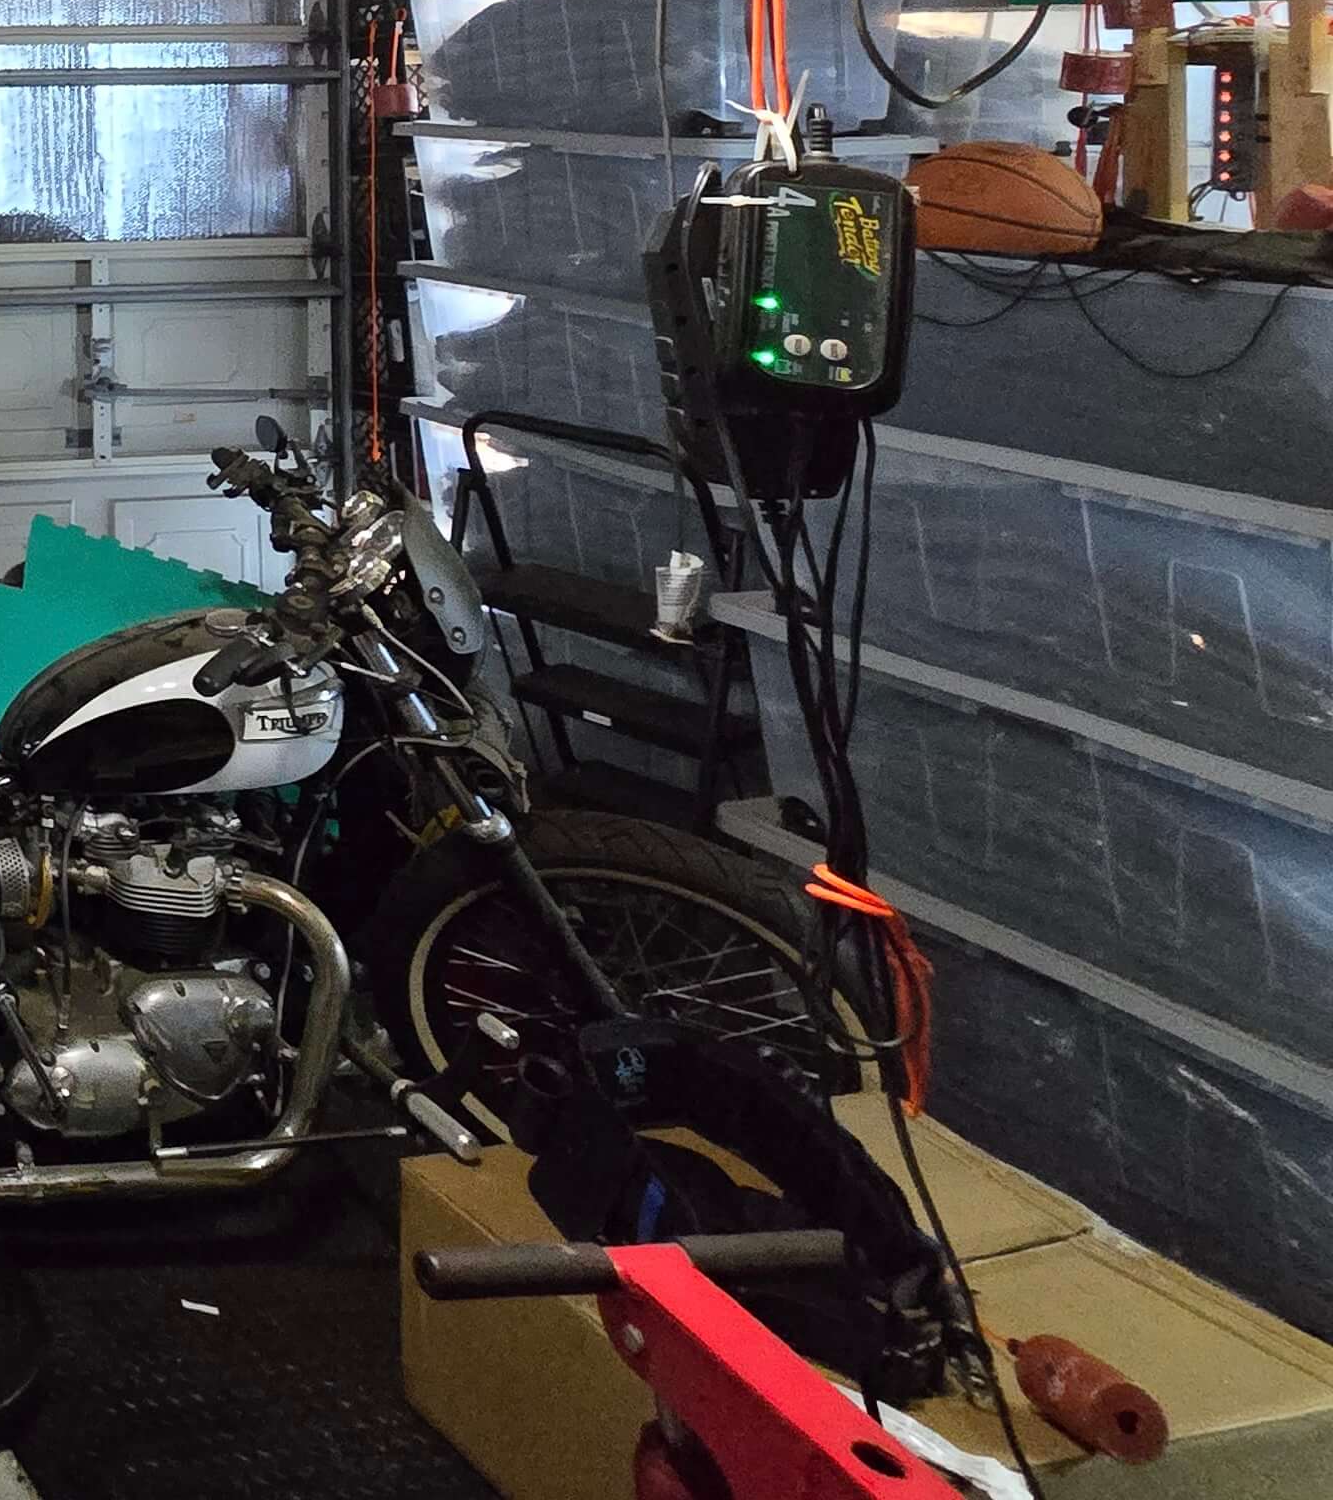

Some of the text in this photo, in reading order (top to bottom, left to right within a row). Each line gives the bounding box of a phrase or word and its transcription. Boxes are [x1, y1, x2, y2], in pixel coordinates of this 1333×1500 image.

[833, 196, 864, 266] Tender
[858, 216, 881, 277] Battery
[255, 712, 330, 735] TRIUPH
